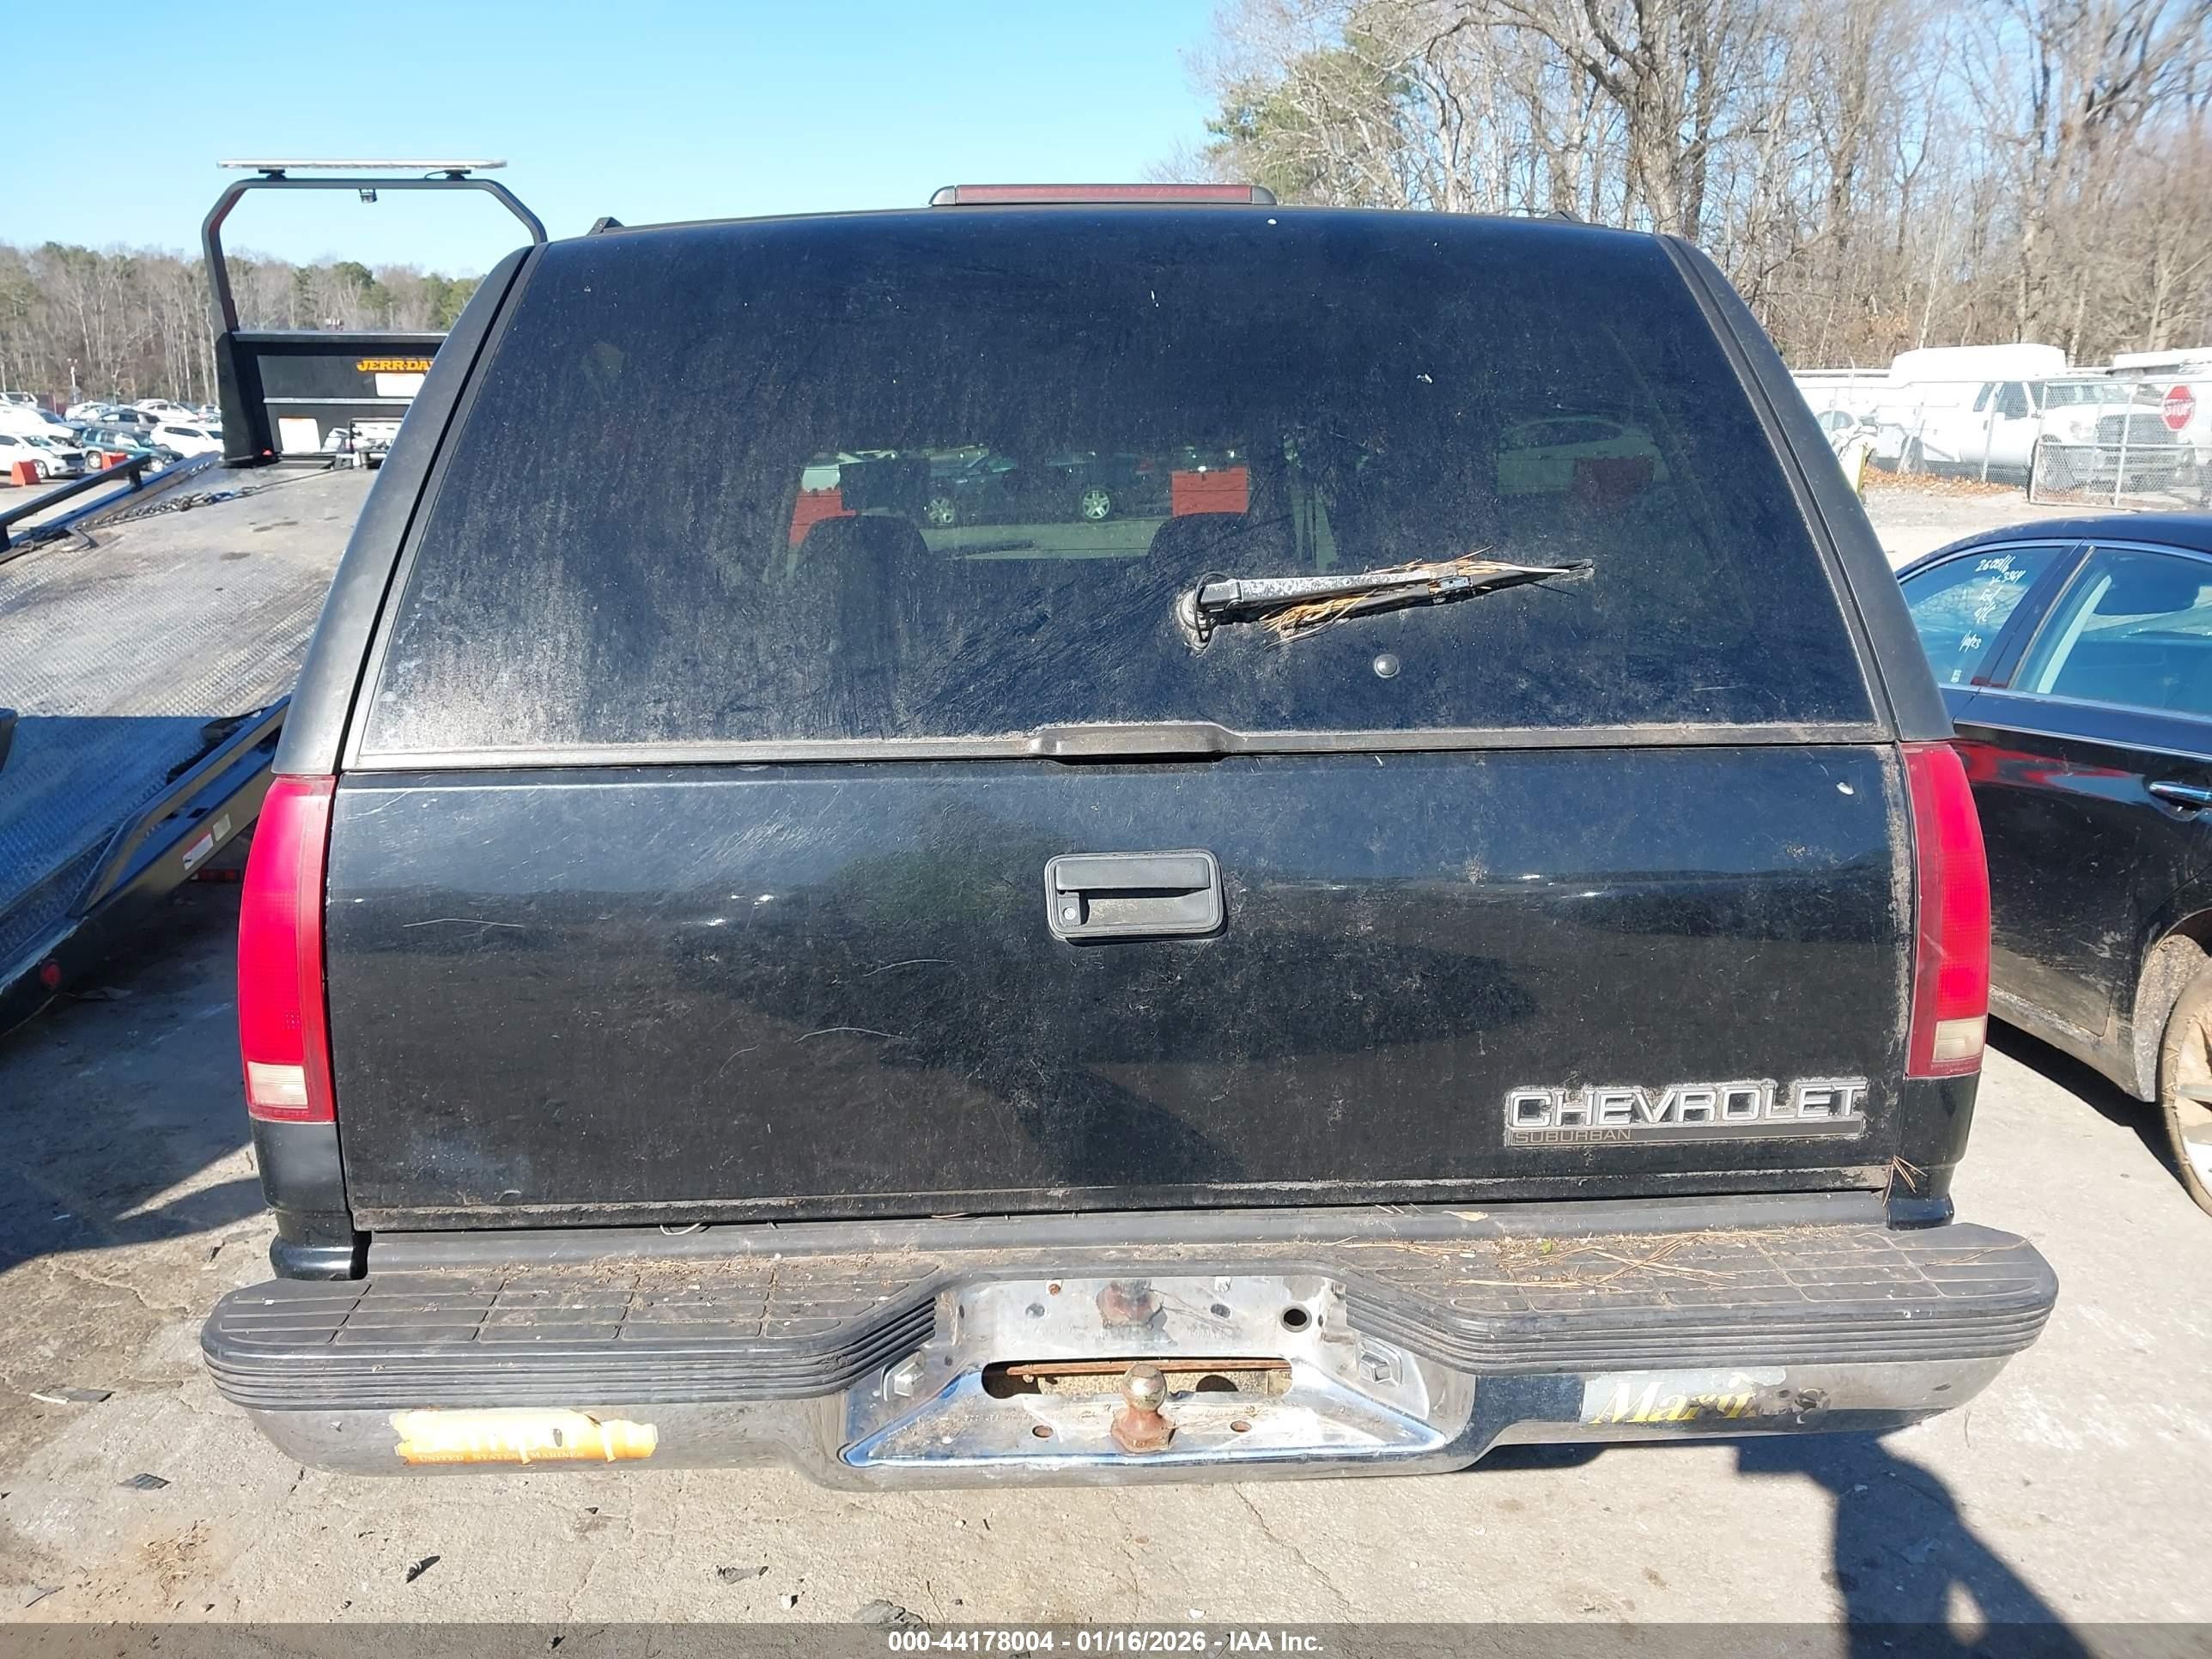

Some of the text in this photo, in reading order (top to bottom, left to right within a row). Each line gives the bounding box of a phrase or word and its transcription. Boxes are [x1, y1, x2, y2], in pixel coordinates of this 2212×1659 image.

[2165, 401, 2192, 417] STOP
[1509, 1079, 1868, 1127] CHEVROLET
[1514, 1128, 1632, 1145] SUBURBAN
[530, 1449, 585, 1459] MARINES
